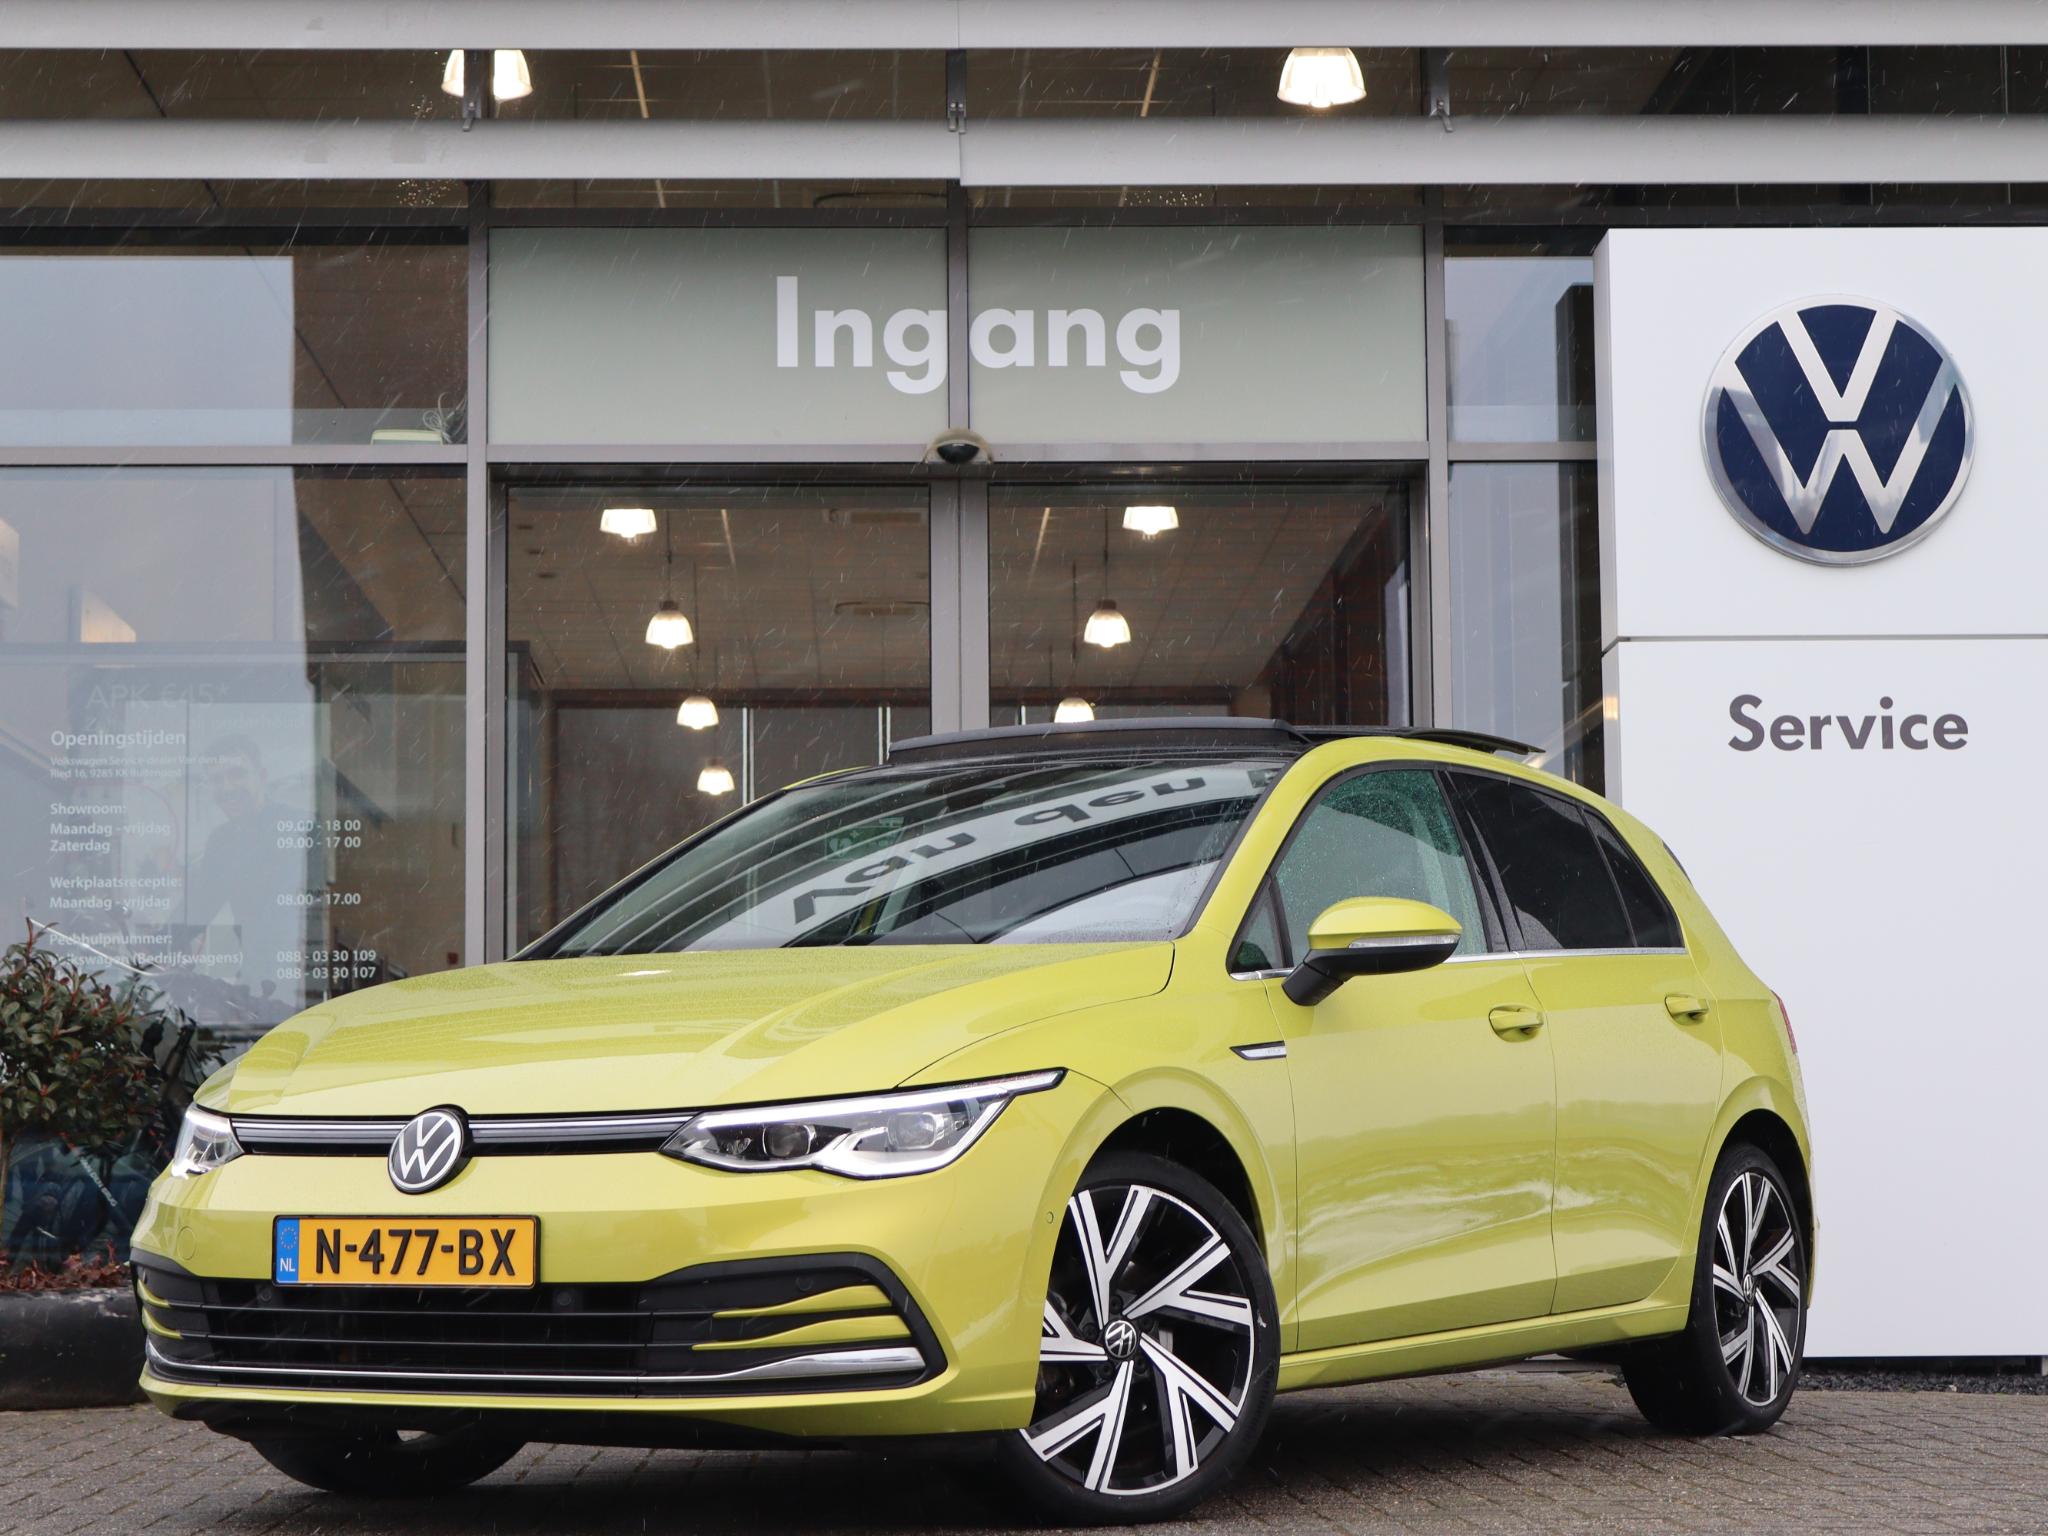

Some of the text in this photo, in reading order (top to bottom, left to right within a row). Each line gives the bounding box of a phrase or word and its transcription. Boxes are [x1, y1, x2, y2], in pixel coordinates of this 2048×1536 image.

[776, 275, 1181, 395] Ingang
[85, 682, 150, 709] APK
[1727, 693, 1969, 752] Service
[50, 729, 187, 749] Openingstijden
[50, 802, 127, 815] Showroom:
[50, 822, 113, 837] Maandag
[123, 822, 171, 837] vrijdag
[276, 819, 314, 832] 09.00
[50, 839, 111, 854] Zaterdag
[276, 836, 314, 849] 09.00
[49, 876, 183, 891] Werkplaatsreceptie:
[50, 896, 113, 911] Maandag
[124, 895, 170, 911] vrijdag
[276, 893, 314, 906] 08.00
[325, 892, 362, 905] 17.00
[132, 950, 244, 968] (Bedrijfswagens)
[276, 950, 302, 962] 088
[312, 950, 329, 962] 03
[332, 950, 349, 962] 30
[352, 949, 377, 962] 109
[276, 967, 302, 979] 088
[312, 967, 329, 979] 03
[332, 966, 349, 979] 30
[352, 966, 377, 979] 107
[315, 1228, 517, 1277] N-477-BX
[279, 1257, 296, 1273] NL
